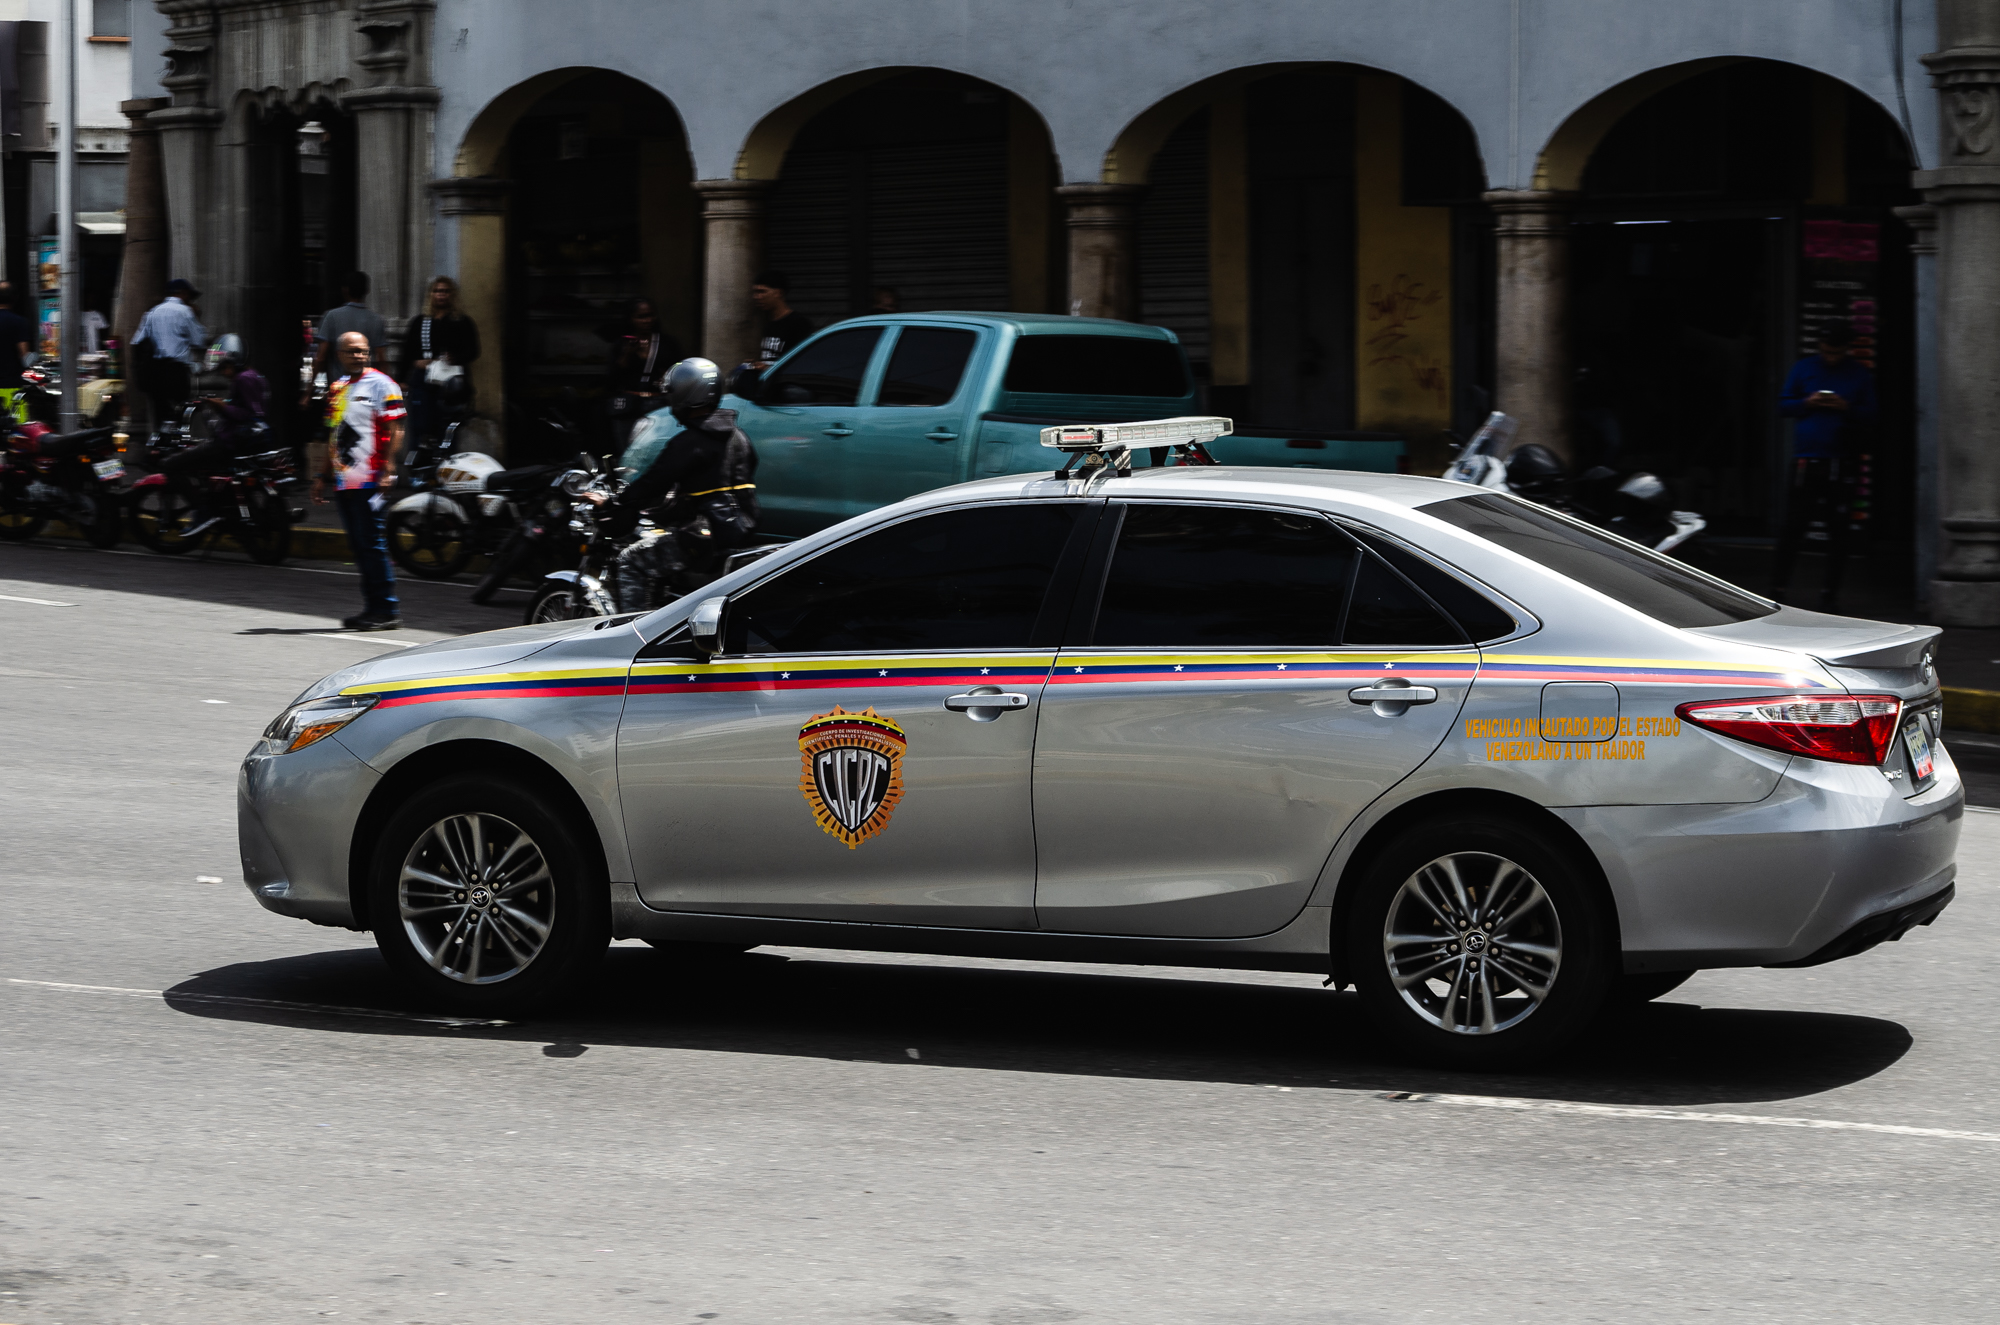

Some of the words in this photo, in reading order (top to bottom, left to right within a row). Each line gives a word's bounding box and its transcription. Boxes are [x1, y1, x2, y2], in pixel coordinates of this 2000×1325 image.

[819, 729, 838, 737] CUERPO
[845, 729, 886, 740] INVESTIGACIONES
[1465, 718, 1522, 738] VEHICULO
[1525, 717, 1589, 737] INCAUTADO
[1593, 716, 1616, 736] POR
[1619, 717, 1633, 736] EL
[1636, 717, 1681, 737] ESTADO
[1486, 741, 1561, 761] VENEZOLANO
[1564, 742, 1572, 760] A
[1575, 741, 1592, 760] UN
[1595, 739, 1646, 760] TRAIDOR
[817, 749, 888, 830] CICPC
